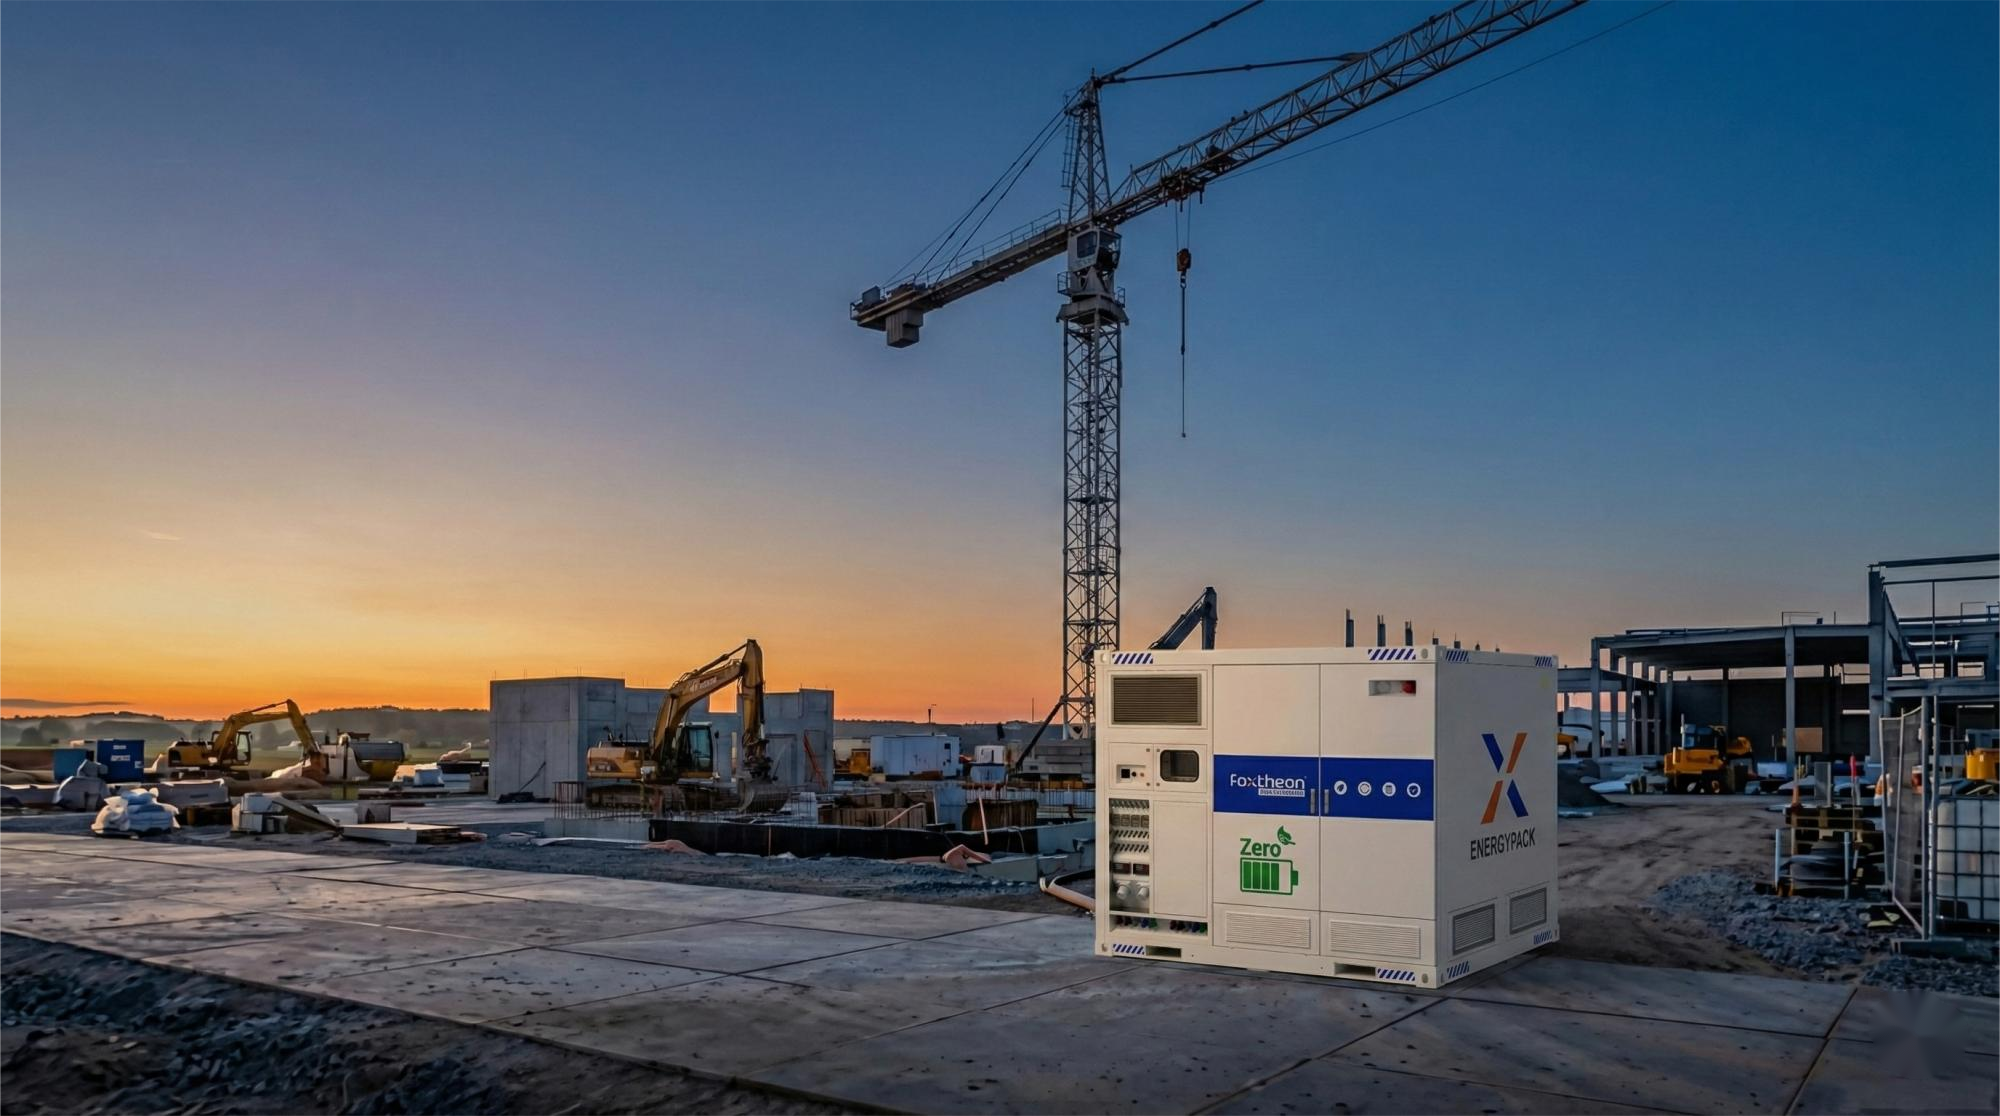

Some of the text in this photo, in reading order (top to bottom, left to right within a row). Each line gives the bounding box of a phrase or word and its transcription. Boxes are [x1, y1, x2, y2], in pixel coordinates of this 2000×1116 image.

[1230, 773, 1305, 789] Foxtheon
[1240, 838, 1281, 857] Zero
[1470, 827, 1535, 860] ENERGYPACK
